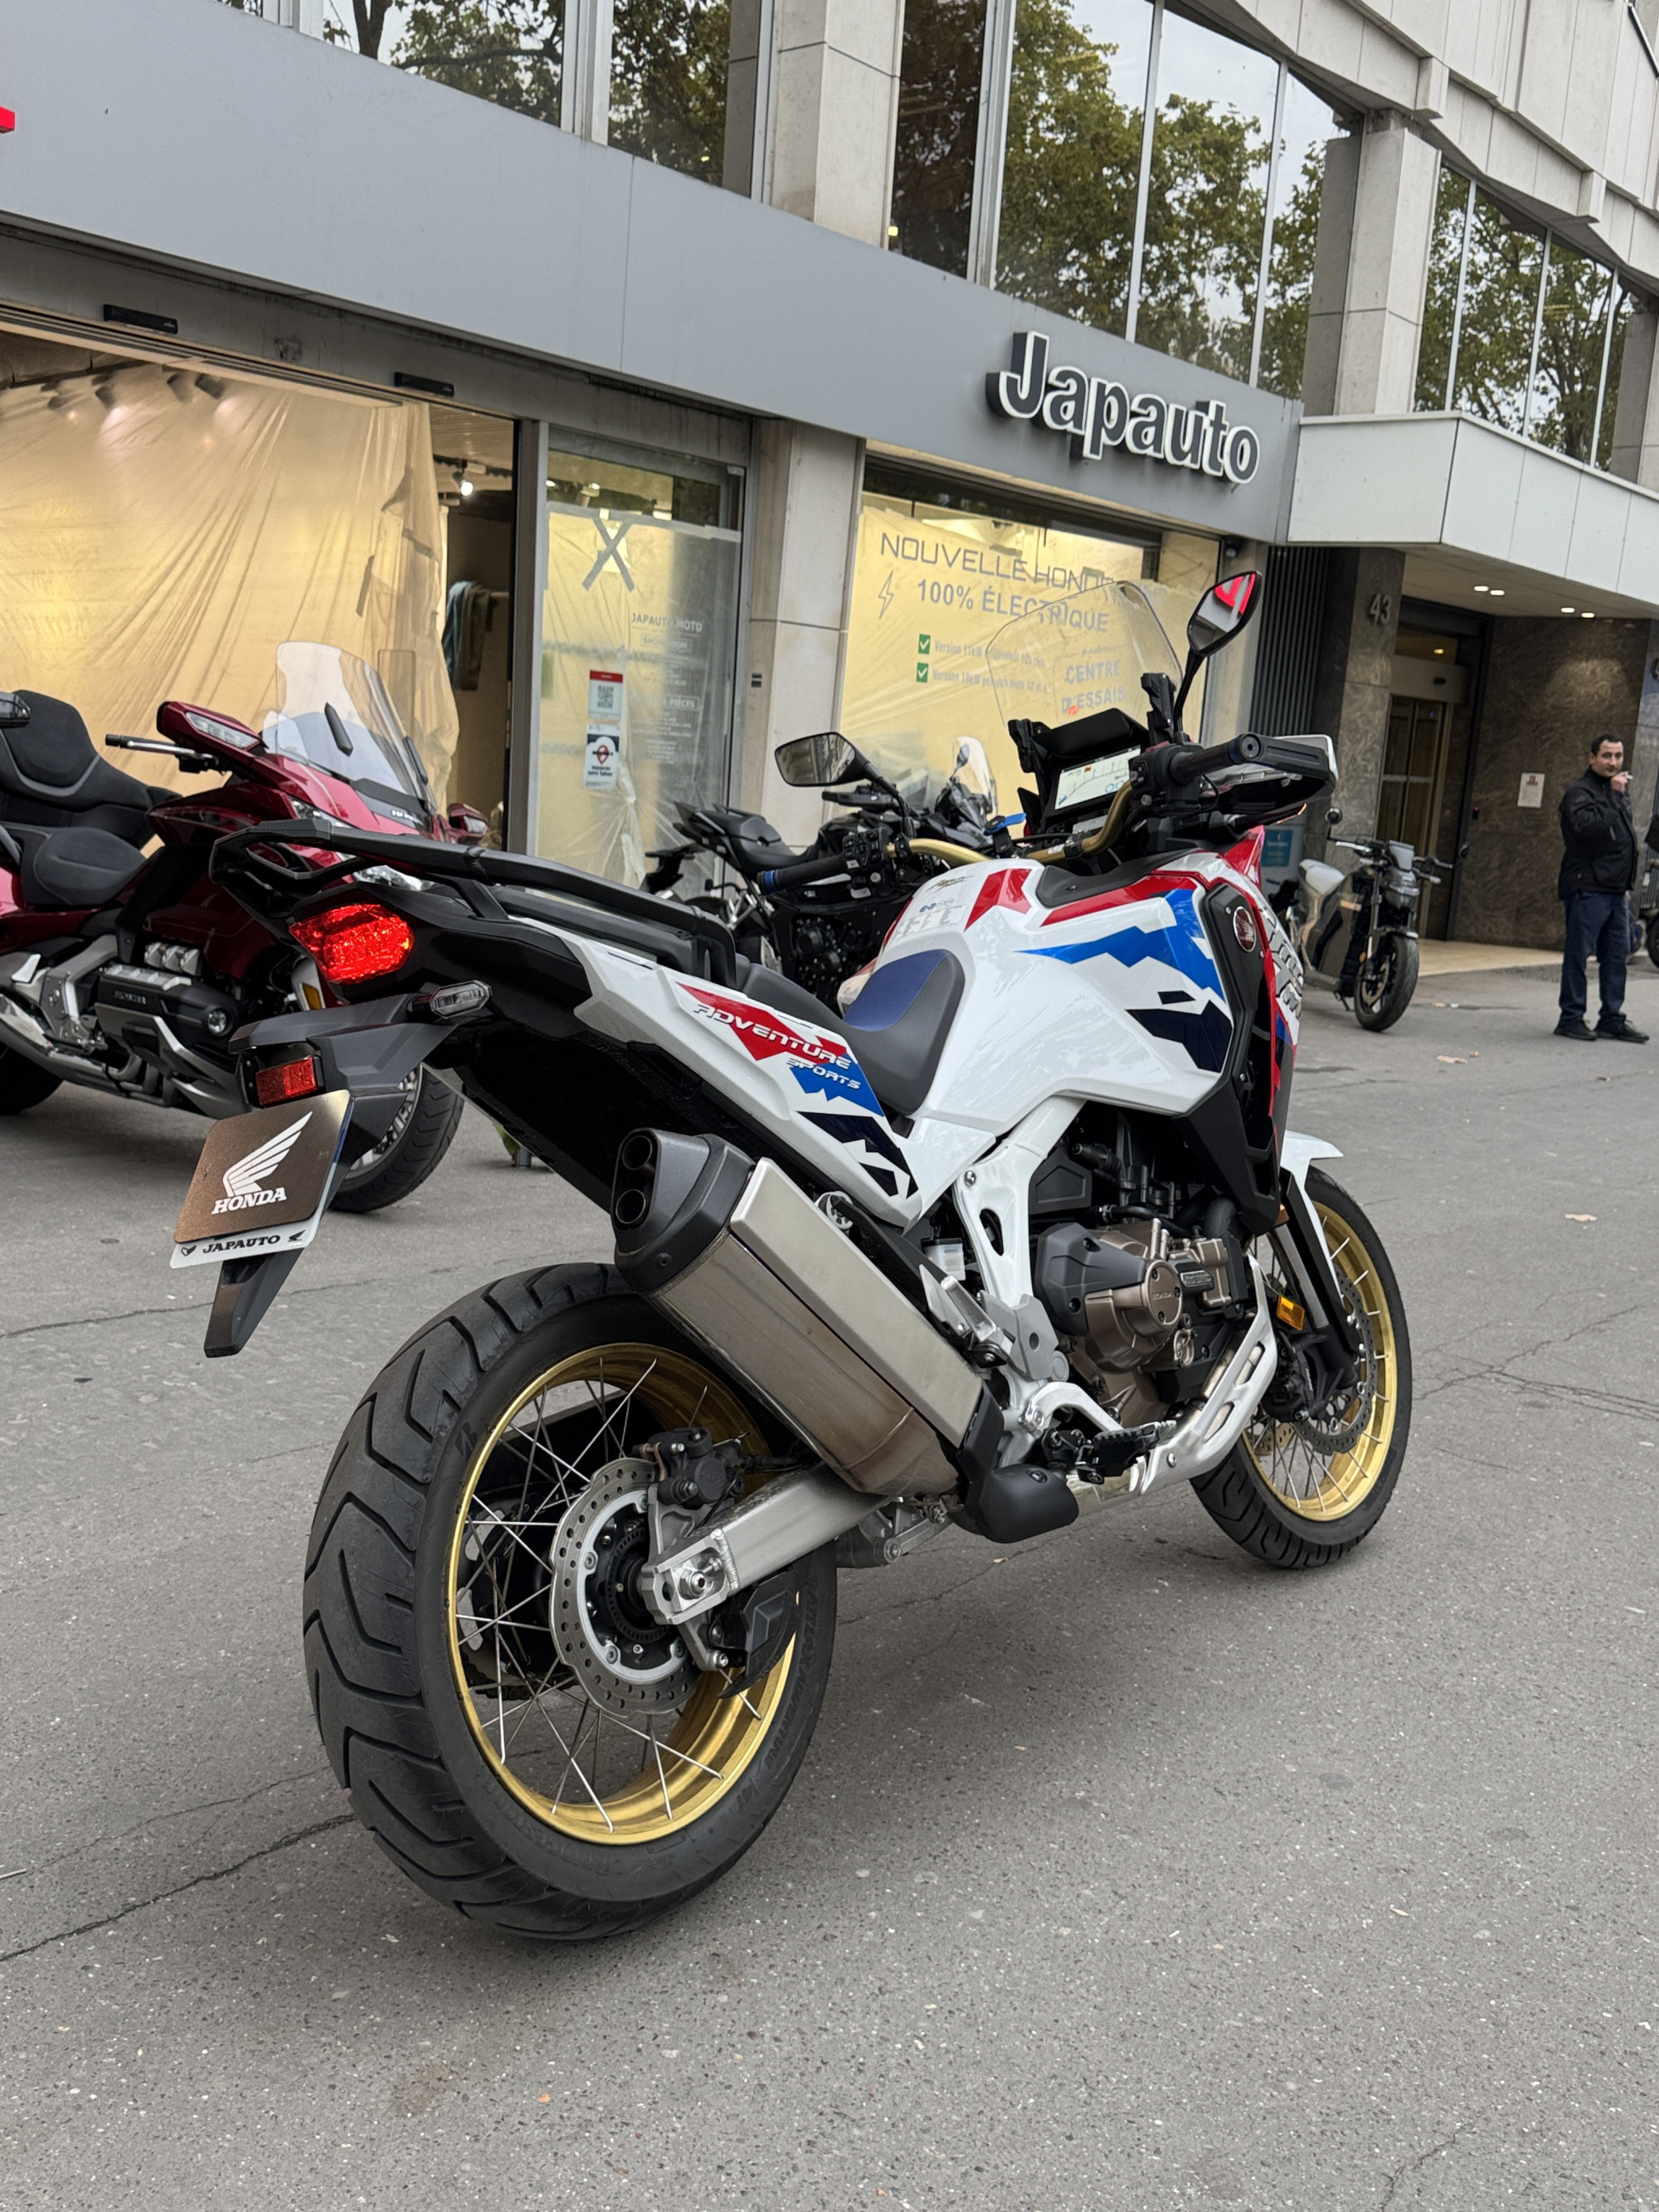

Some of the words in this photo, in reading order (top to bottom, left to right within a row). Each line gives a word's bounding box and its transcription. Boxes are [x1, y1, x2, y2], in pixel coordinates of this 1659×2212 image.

[995, 330, 1260, 484] Japauto
[880, 532, 1029, 582] NOUVELLE
[917, 578, 975, 611] 100%
[982, 585, 1110, 633] ÉLECTRIQUE
[1370, 593, 1392, 624] 43
[631, 612, 673, 629] JAPAUT
[676, 619, 703, 633] MOTO
[934, 639, 961, 654] Version
[932, 668, 960, 682] Version
[1065, 659, 1121, 685] CENTRE
[693, 1003, 852, 1071] ADVENTURE
[786, 1057, 861, 1091] SPORTS
[211, 1187, 288, 1215] HONDA
[202, 1234, 281, 1256] JAPAUTO
